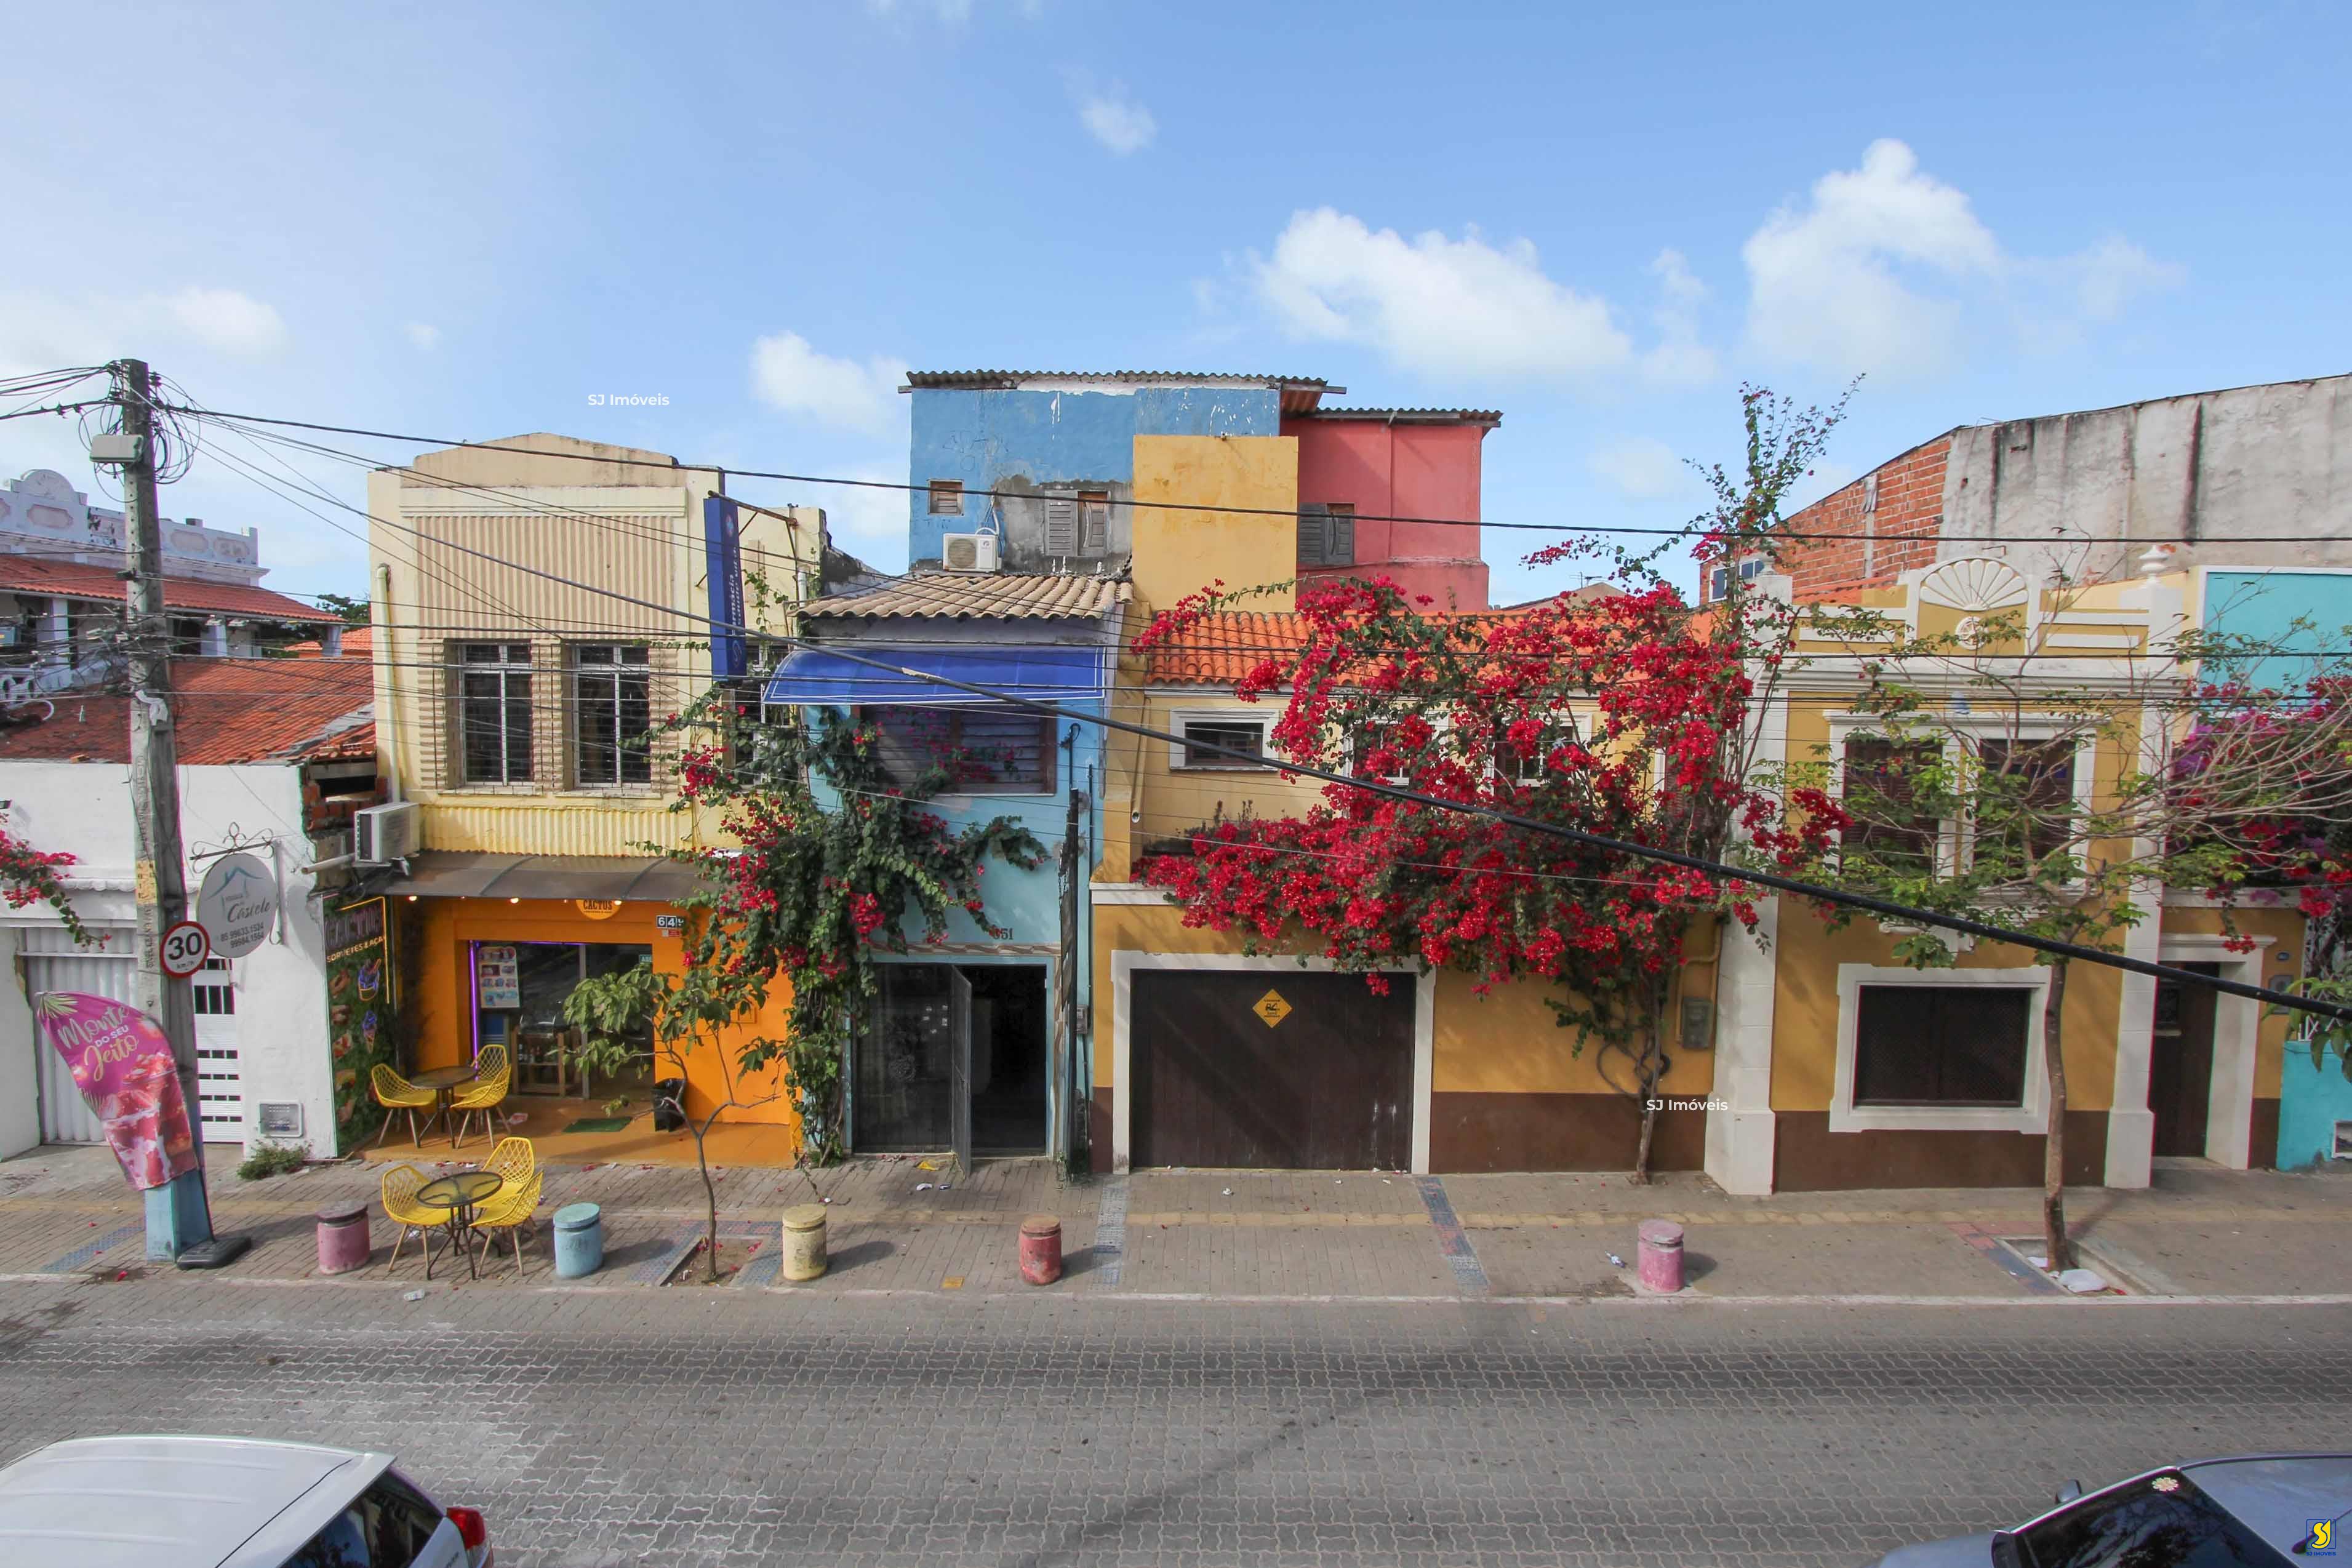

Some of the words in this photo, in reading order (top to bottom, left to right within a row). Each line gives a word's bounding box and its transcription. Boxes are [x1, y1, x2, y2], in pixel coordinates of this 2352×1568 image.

[583, 900, 612, 910] CACTUS
[168, 932, 202, 960] 30
[57, 1006, 129, 1049] Monte
[95, 1036, 110, 1047] DO
[110, 1025, 129, 1038] SEU
[84, 1035, 140, 1082] Jeito
